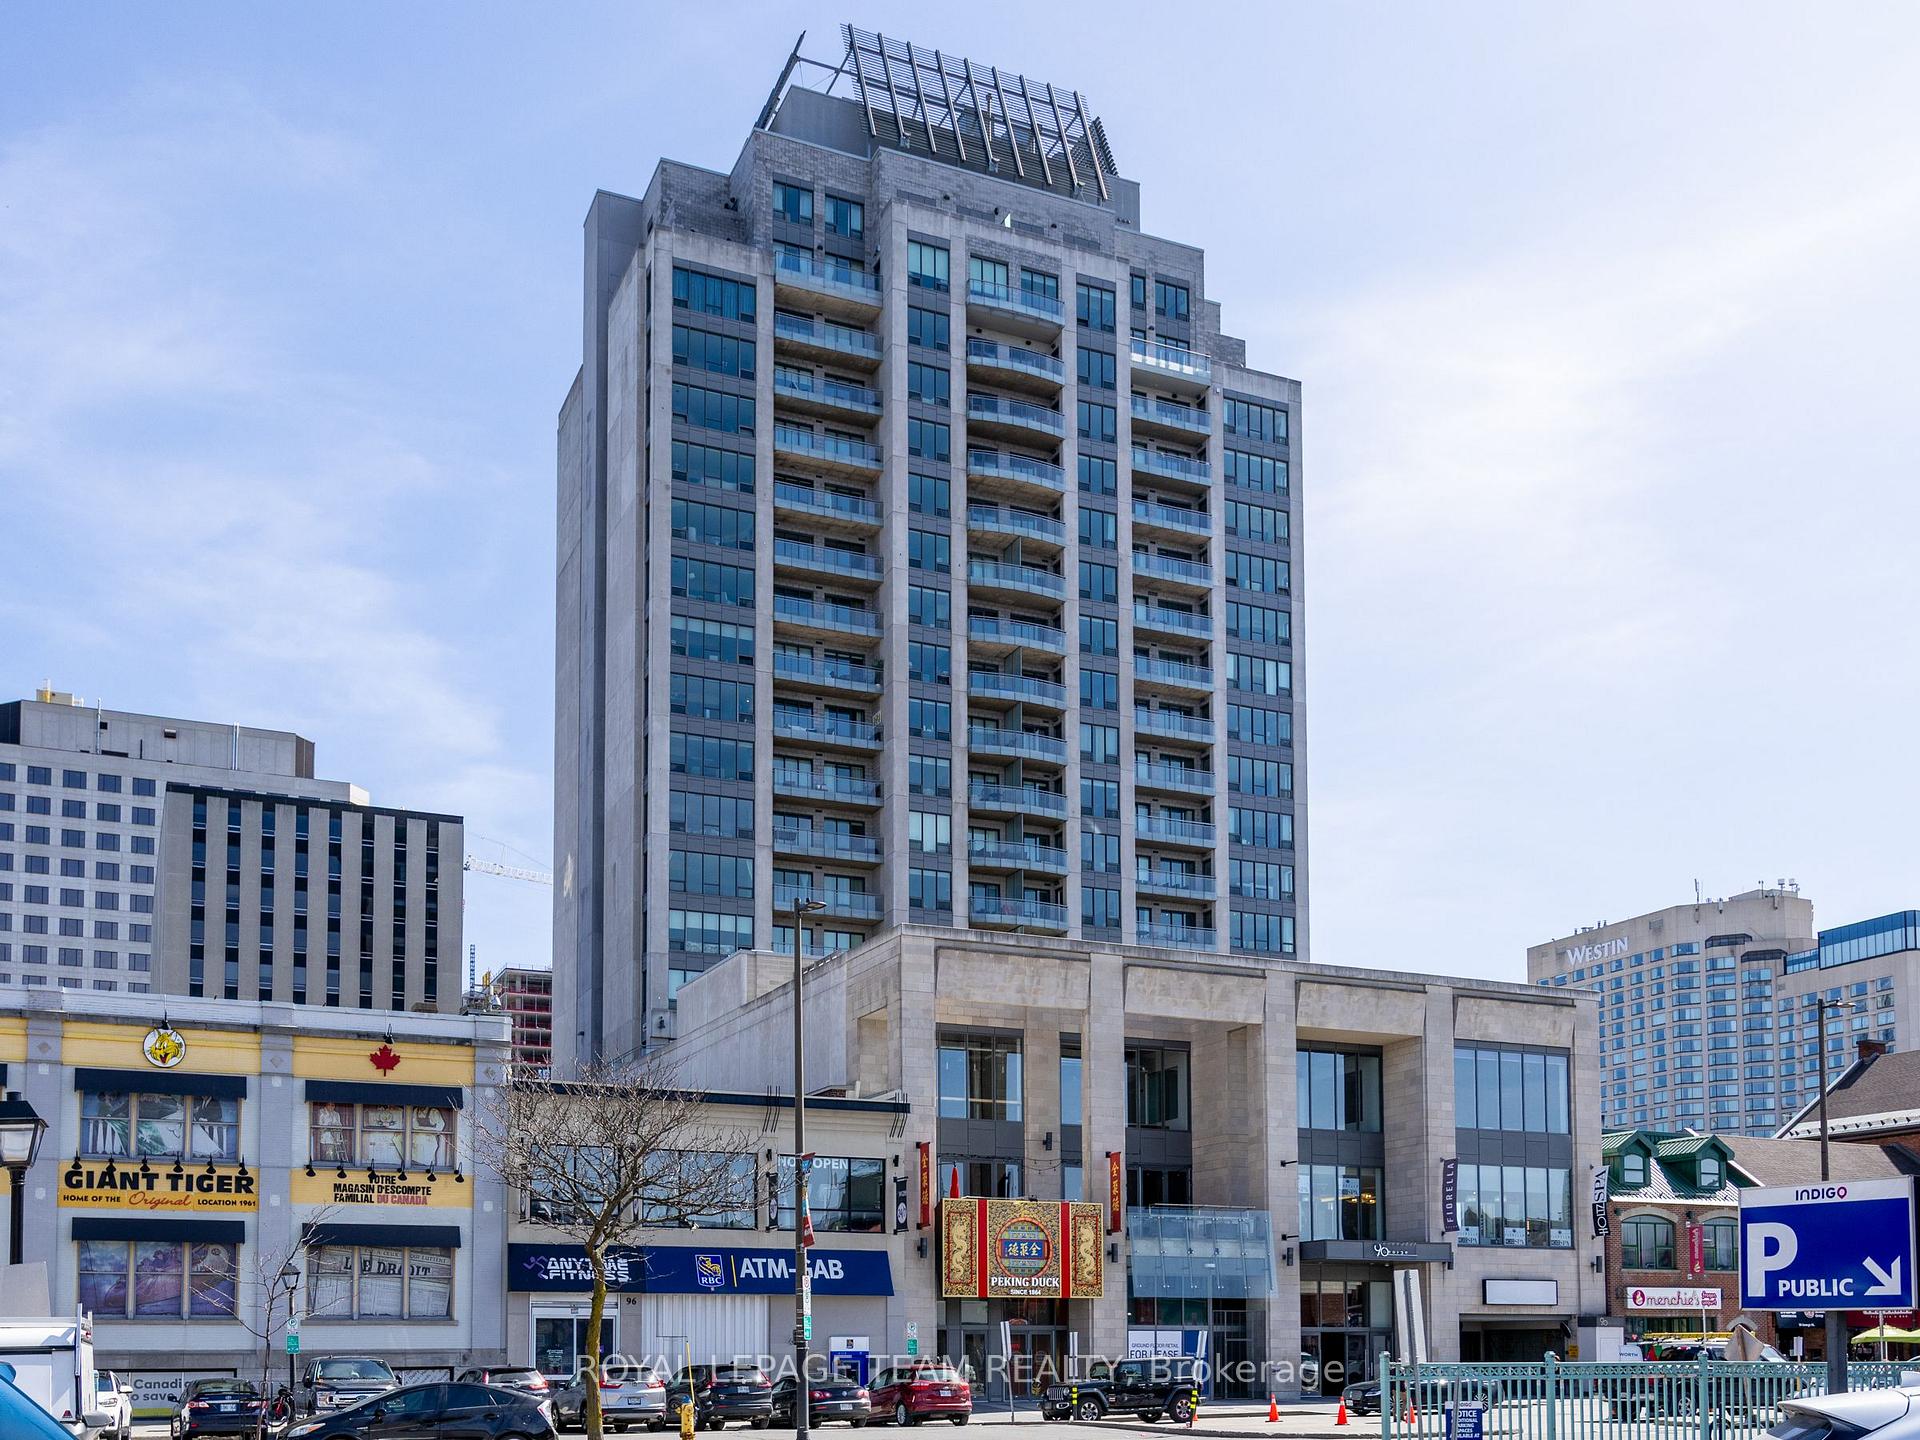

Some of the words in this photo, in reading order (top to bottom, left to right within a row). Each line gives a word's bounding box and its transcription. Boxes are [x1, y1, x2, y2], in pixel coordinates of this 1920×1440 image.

[1566, 936, 1629, 966] WESTIN
[813, 1157, 848, 1169] OPEN
[64, 1170, 159, 1190] GIANT
[166, 1173, 255, 1194] TIGER
[333, 1183, 375, 1194] MAGASIN
[377, 1185, 432, 1195] D'ESCOMPTE
[1595, 1169, 1606, 1202] SPA
[334, 1193, 374, 1203] FAMILIAL
[377, 1194, 389, 1204] DU
[391, 1195, 428, 1205] CANADA
[1446, 1163, 1454, 1223] FIORELLA
[1795, 1187, 1847, 1201] INDIGO
[128, 1191, 191, 1210] Original
[343, 1256, 372, 1272] LE
[377, 1261, 431, 1276] DROIT
[547, 1257, 628, 1271] ANYTME
[1746, 1222, 1798, 1297] P
[549, 1270, 630, 1282] FITNSS
[701, 1277, 722, 1285] RBC
[991, 1277, 1029, 1287] PEKING
[1031, 1277, 1060, 1287] DUCK
[1778, 1278, 1854, 1297] PUBLIC
[626, 1297, 637, 1305] 96
[1647, 1290, 1700, 1307] menchie's
[1130, 1350, 1148, 1359] FOR
